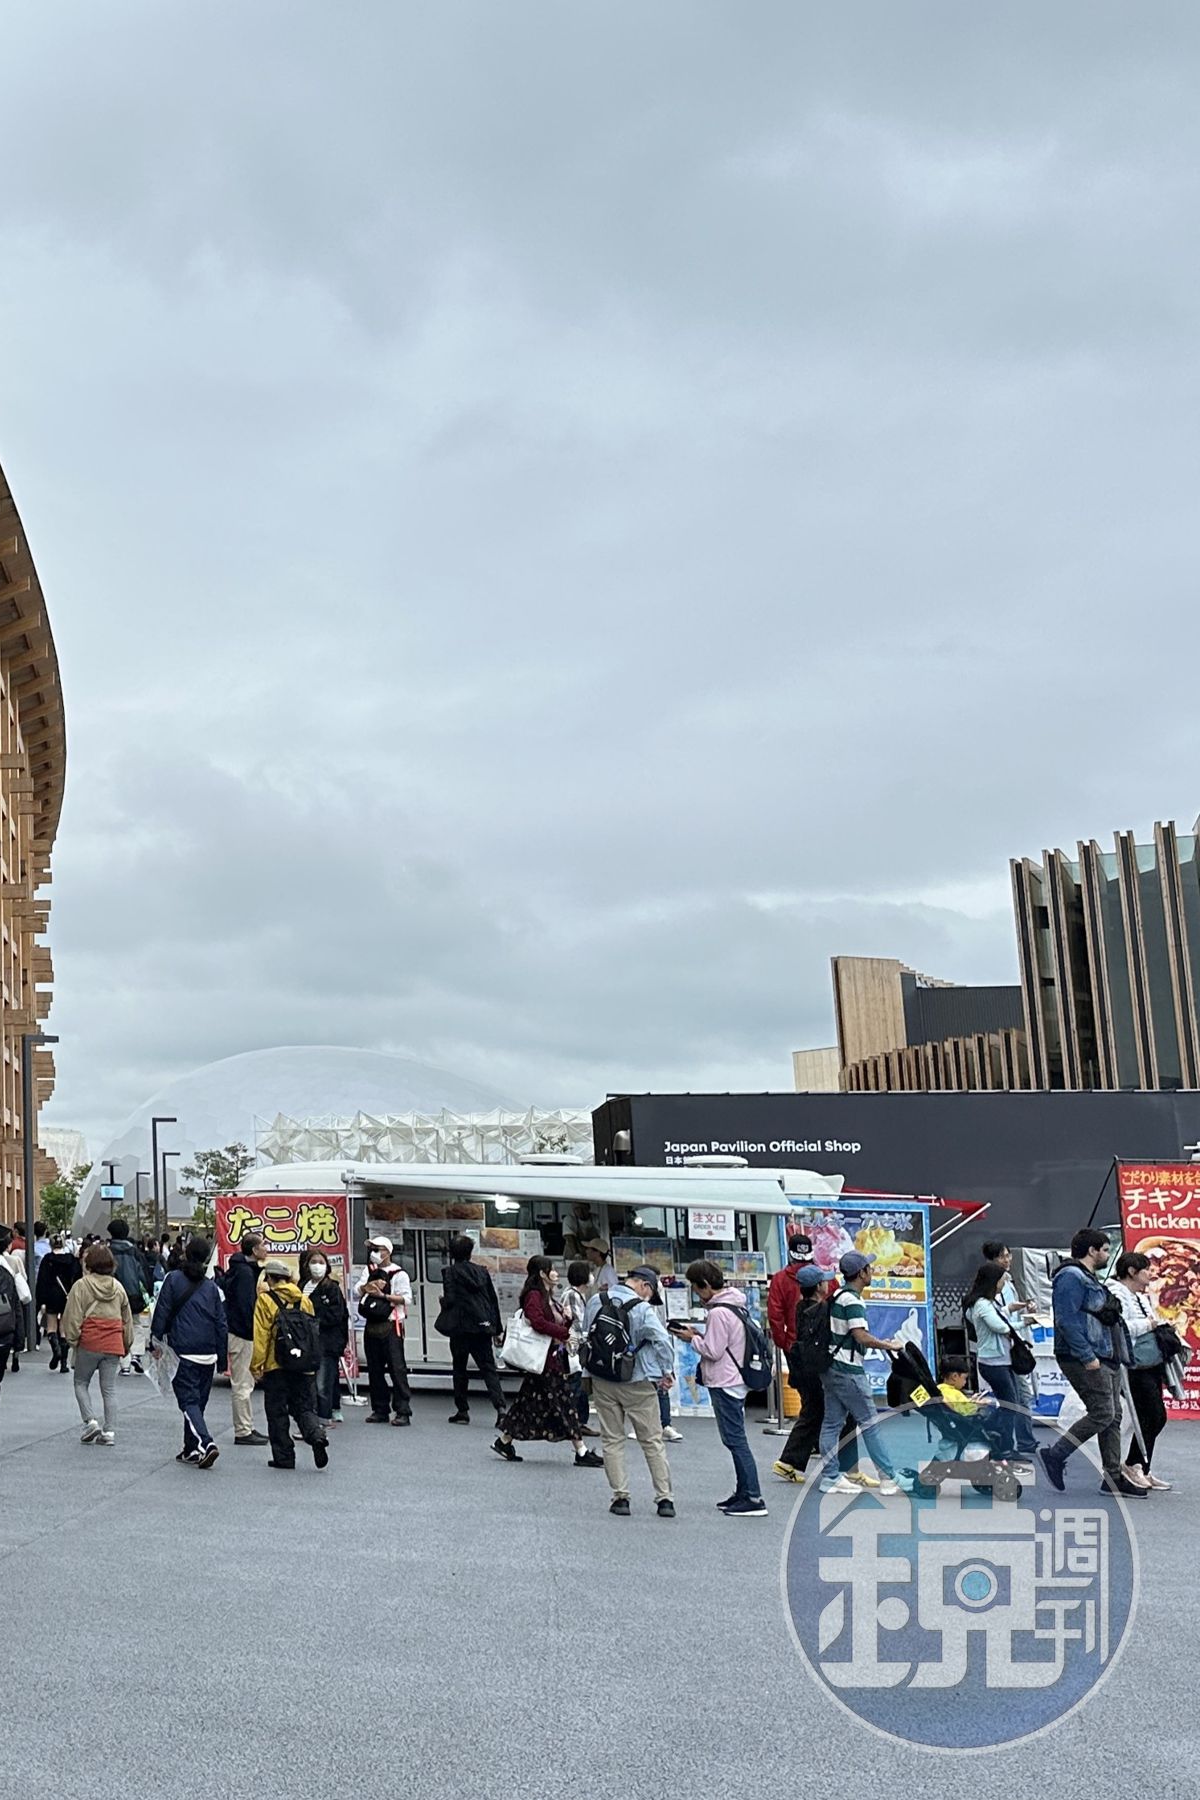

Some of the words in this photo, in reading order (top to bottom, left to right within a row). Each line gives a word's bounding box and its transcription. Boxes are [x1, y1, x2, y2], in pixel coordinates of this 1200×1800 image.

[664, 1141, 708, 1154] Japan
[711, 1141, 767, 1153] Pavilion
[769, 1140, 822, 1153] Official
[824, 1140, 861, 1154] Shop
[692, 1212, 726, 1224] 注文口
[1126, 1213, 1200, 1229] Chicken
[265, 1242, 308, 1252] akoyaki
